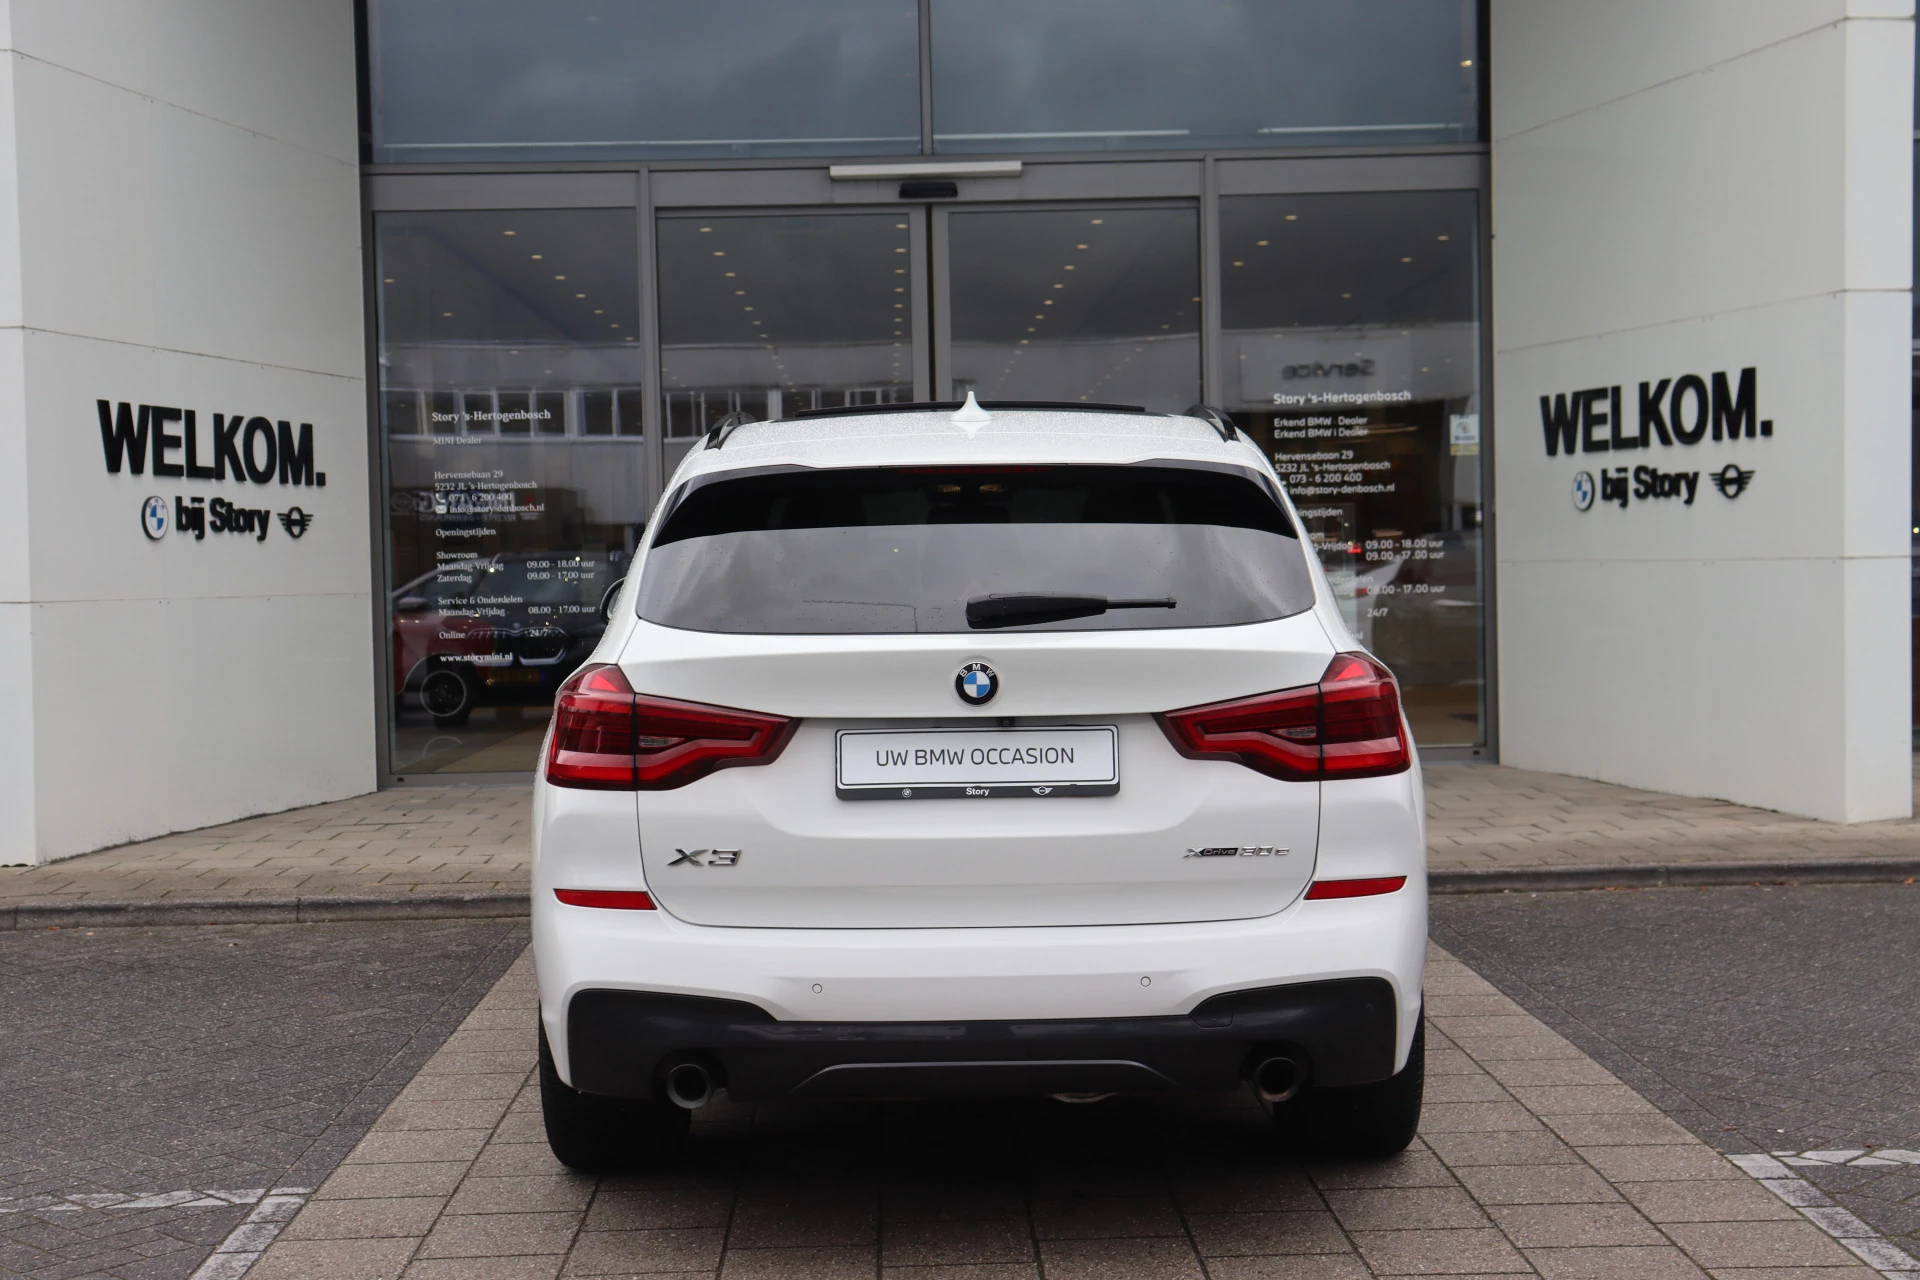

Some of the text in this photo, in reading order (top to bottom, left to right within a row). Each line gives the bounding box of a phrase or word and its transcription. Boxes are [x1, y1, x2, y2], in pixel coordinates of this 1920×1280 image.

[1273, 389, 1412, 406] Story 's-Hertogenbosch
[432, 409, 551, 424] Story 's-Hertogenbosch
[1540, 367, 1773, 457] WELKOM.
[1274, 416, 1368, 427] Erkend BMW Dealer
[1274, 429, 1306, 439] Erkend
[1307, 428, 1332, 437] BMW
[1338, 427, 1368, 437] Dealer
[96, 399, 327, 487] WELKOM.
[433, 436, 482, 445] MINI Dealer
[1275, 450, 1354, 461] Hervensebaan 29
[1275, 461, 1391, 473] 5232 JL 's-Hertogenbosch
[434, 470, 504, 480] Hervensebaan 29
[1289, 473, 1307, 483] 073
[1315, 473, 1322, 482] 6
[1323, 472, 1342, 482] 200
[1343, 472, 1362, 482] 400
[434, 480, 538, 491] 5232 JL 's-Hertogenbosch
[1289, 483, 1396, 496] info@story-denbosch.nl
[1633, 465, 1700, 506] Story
[479, 493, 495, 502] 200
[496, 492, 512, 501] 400
[449, 503, 545, 515] info@story-denbosch.nl
[1300, 507, 1343, 519] ingstijden
[209, 497, 271, 542] Story
[435, 527, 496, 538] Openingstijden
[1365, 540, 1393, 549] 09.00
[1401, 539, 1427, 548] 18.00
[1429, 540, 1444, 548] uur
[436, 551, 478, 559] Showroom
[1365, 551, 1393, 561] 09.00
[1429, 551, 1445, 559] uur
[437, 562, 504, 572] Maandag-Vrijdag
[526, 560, 550, 568] 09.00
[557, 559, 579, 568] 18.00
[580, 560, 595, 568] uur
[437, 574, 472, 583] Zaterdag
[526, 572, 550, 580] 09.00
[557, 571, 579, 580] 17.00
[1430, 585, 1446, 593] uur
[437, 597, 468, 606] Service
[476, 596, 523, 605] Onderdelen
[438, 607, 505, 617] Maandag-Vrijdag
[528, 606, 551, 614] 08.00
[558, 605, 580, 614] 17.00
[1367, 608, 1389, 617] 24/7
[439, 631, 466, 639] Online
[440, 652, 513, 663] www.storymini.nl
[875, 746, 1076, 768] UW BMW OCCASION
[965, 787, 991, 799] Story
[667, 848, 741, 866] X3
